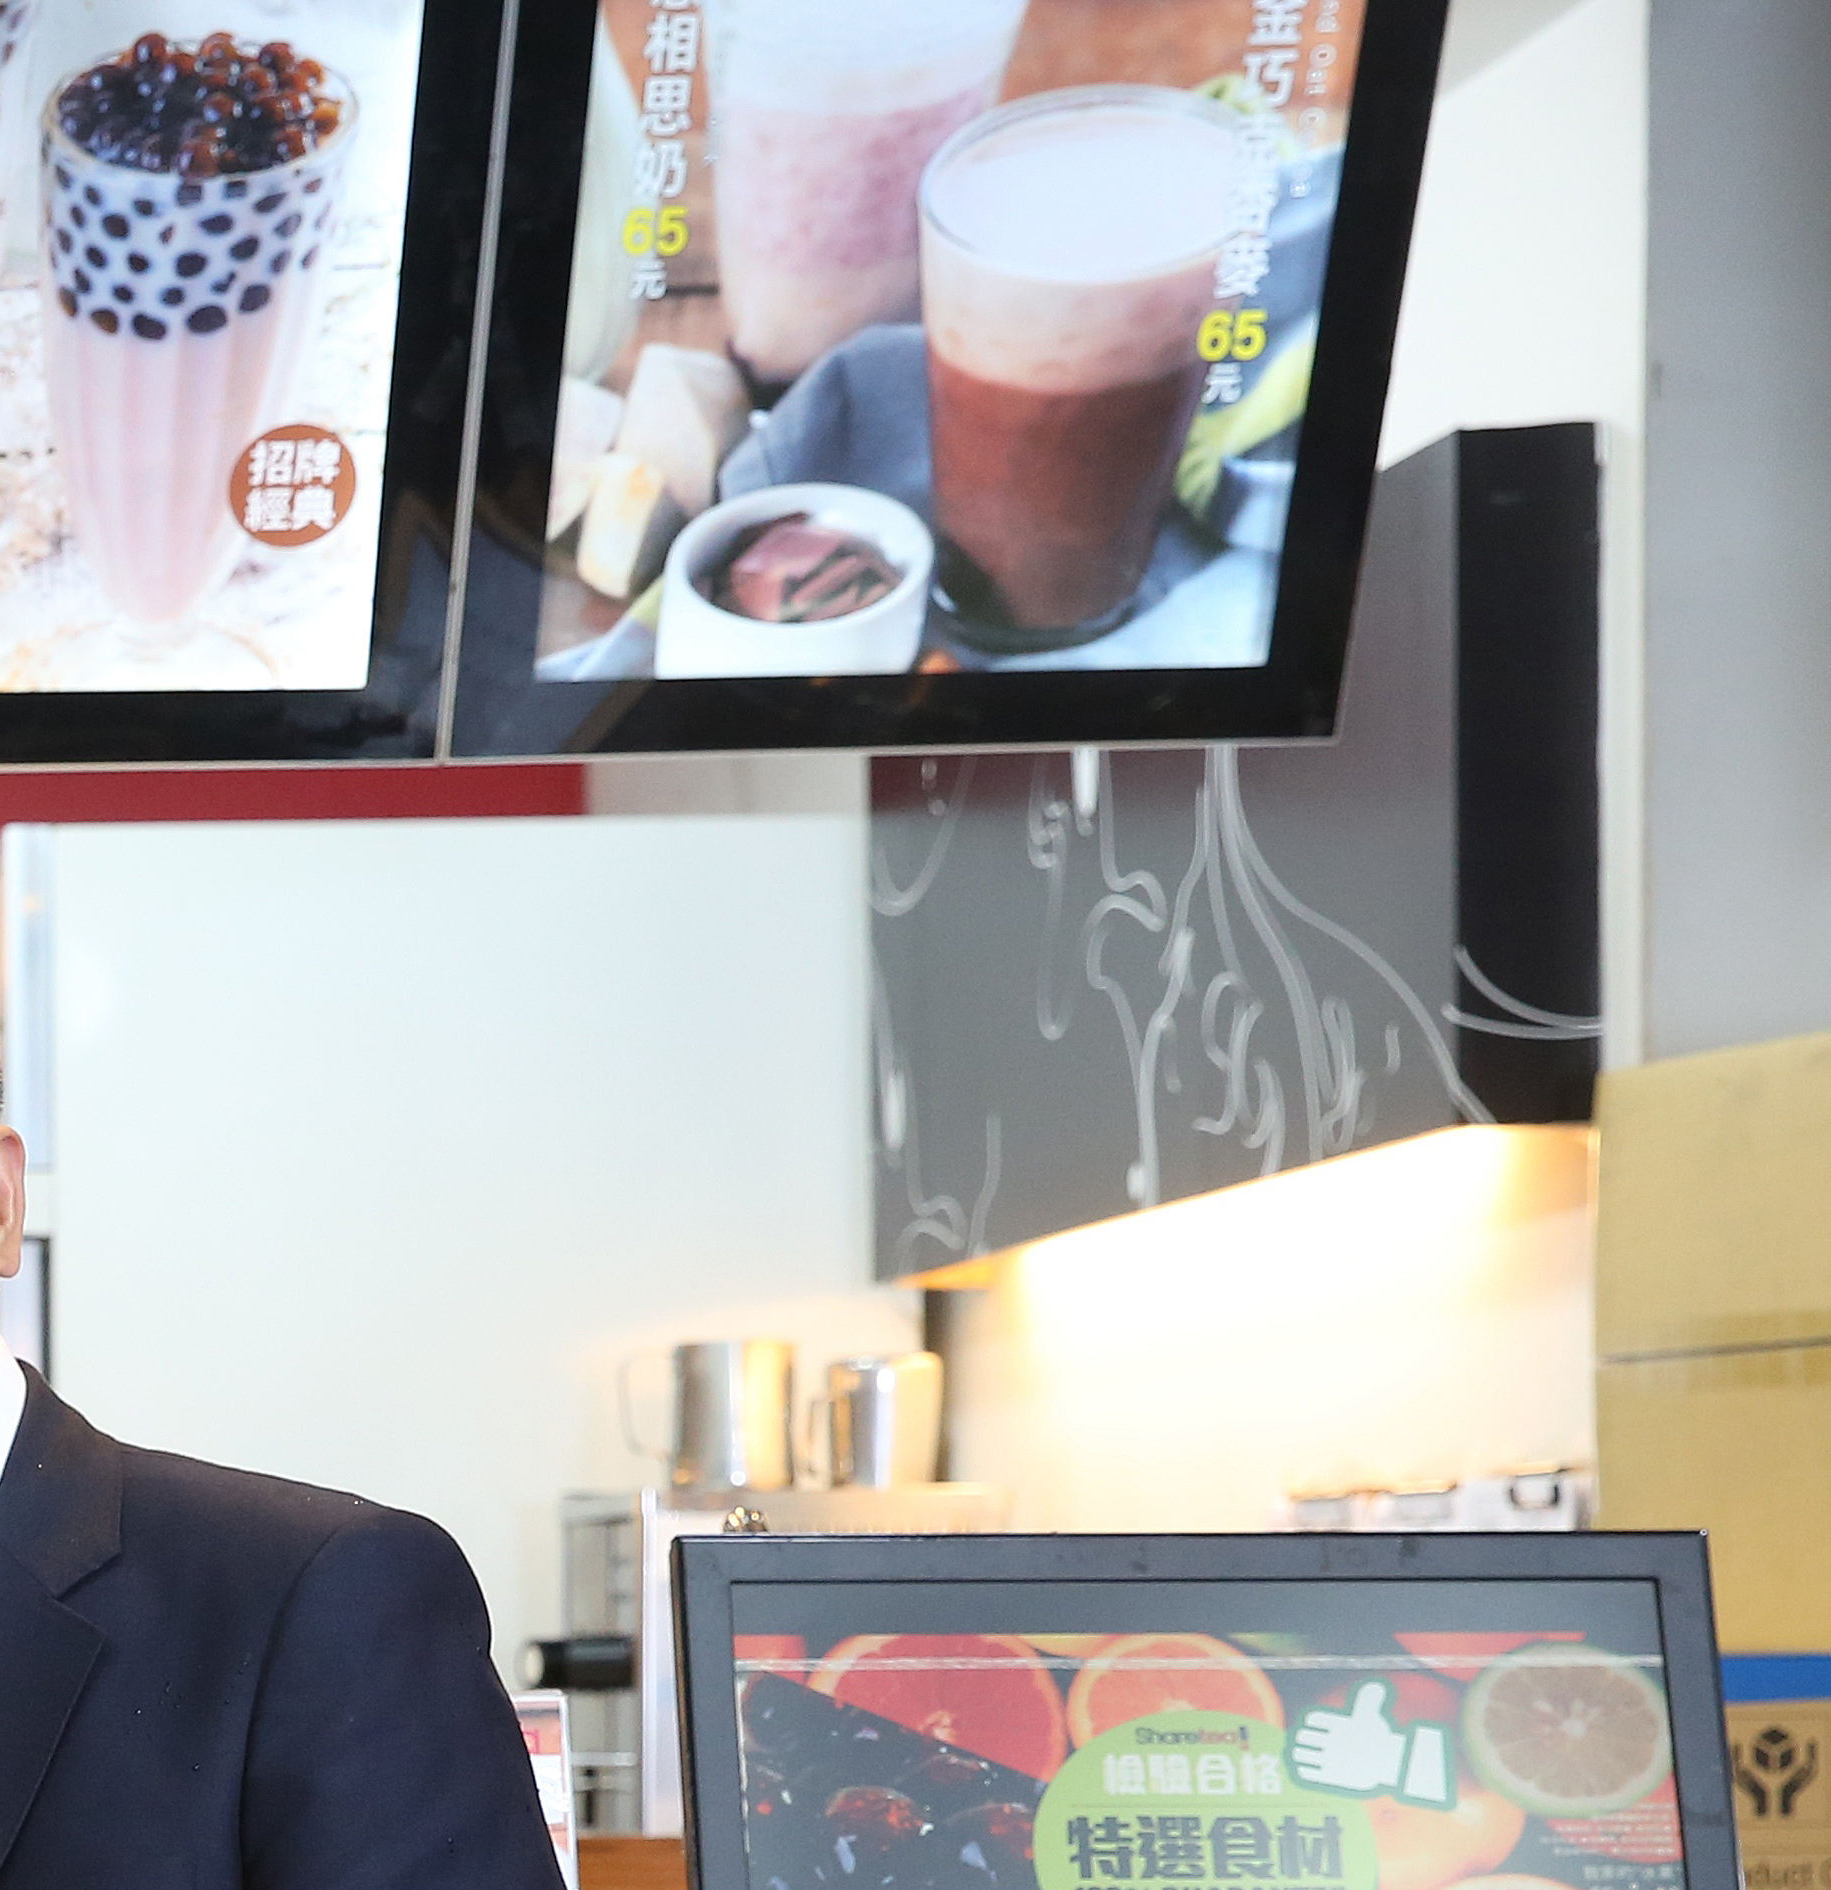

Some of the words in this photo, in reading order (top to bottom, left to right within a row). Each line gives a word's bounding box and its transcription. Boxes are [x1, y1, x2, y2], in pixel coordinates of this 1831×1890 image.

[635, 0, 700, 198] 相思奶
[622, 205, 688, 256] 65
[628, 257, 667, 300] 元
[1196, 308, 1267, 362] 65
[1201, 362, 1243, 404] 元
[249, 439, 341, 488] 招牌
[245, 486, 337, 534] 經典
[1103, 1752, 1282, 1796] 檢驗合格
[1067, 1815, 1343, 1881] 特選食材
